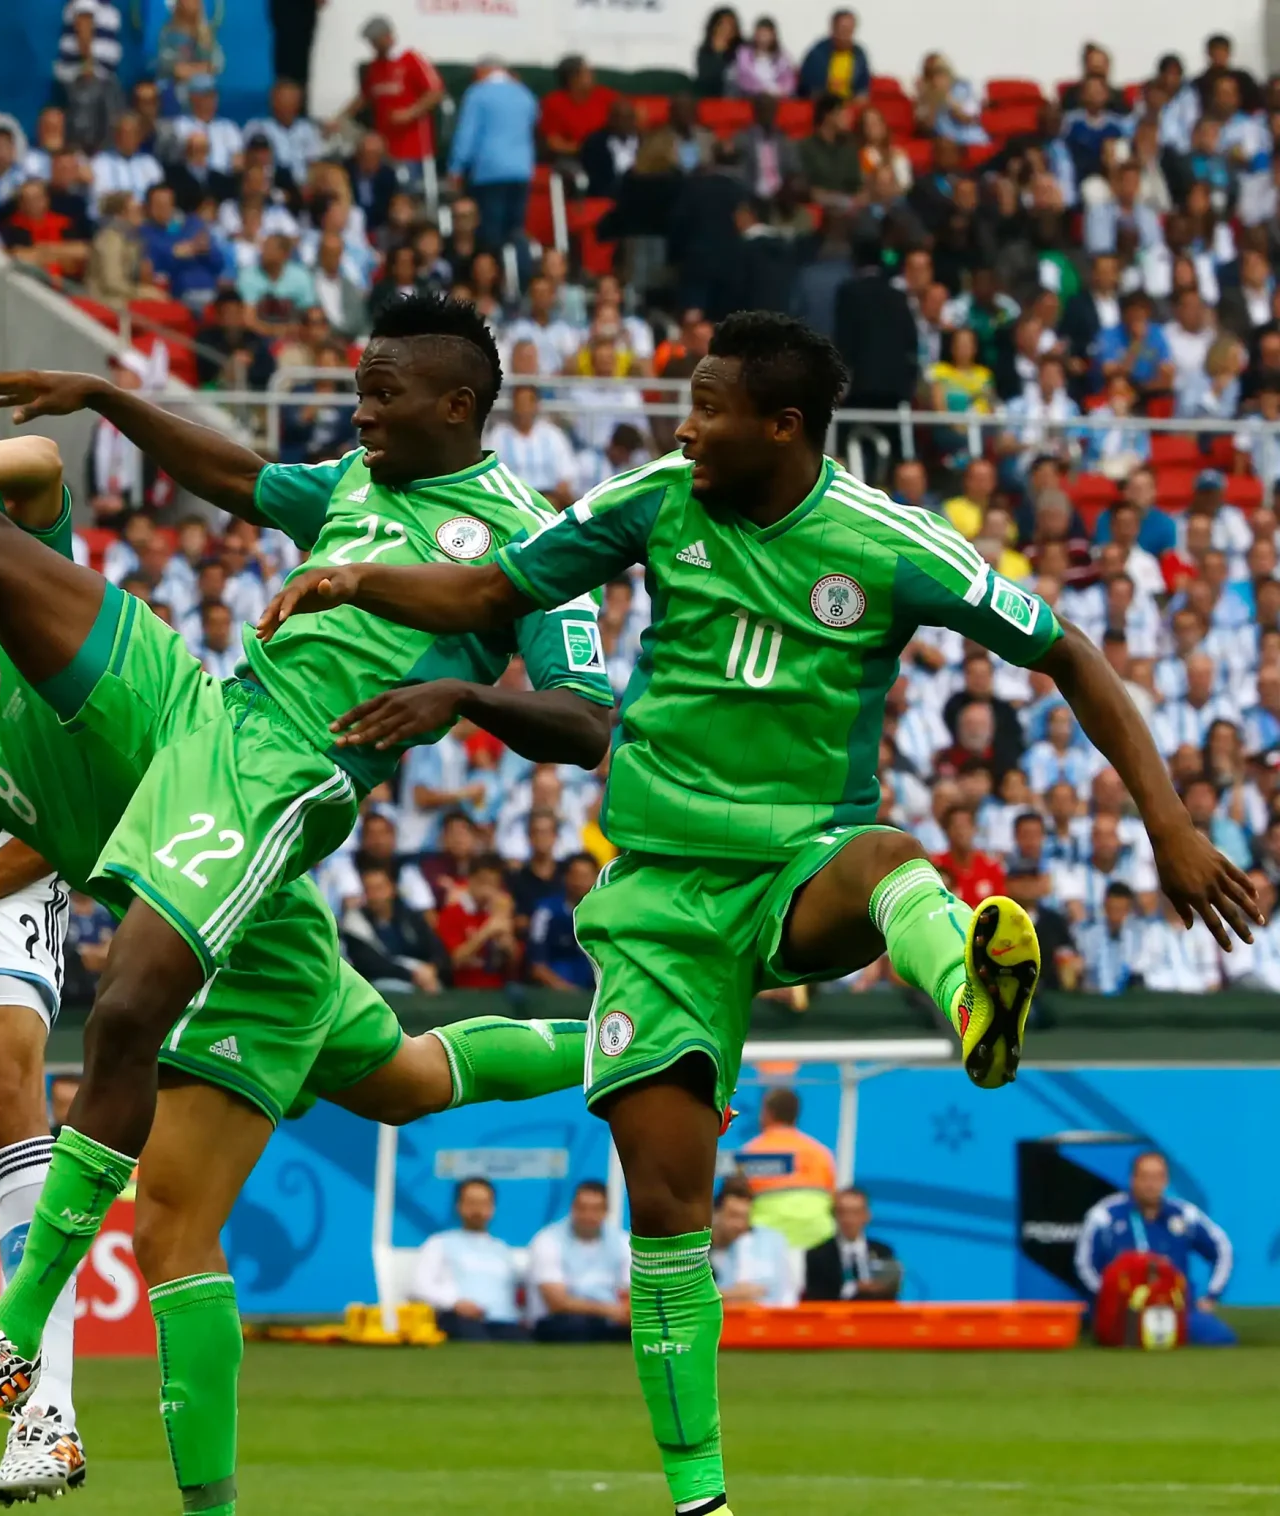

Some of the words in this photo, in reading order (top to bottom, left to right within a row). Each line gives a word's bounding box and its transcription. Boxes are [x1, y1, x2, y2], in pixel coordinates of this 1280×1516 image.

[327, 514, 408, 566] 22
[676, 552, 712, 569] adidas
[849, 582, 865, 615] FEDERATION
[725, 607, 783, 688] 10
[153, 813, 245, 889] 22
[19, 913, 41, 960] 2
[209, 1045, 242, 1062] adidas
[642, 1342, 692, 1355] NFF
[159, 1401, 185, 1414] FF
